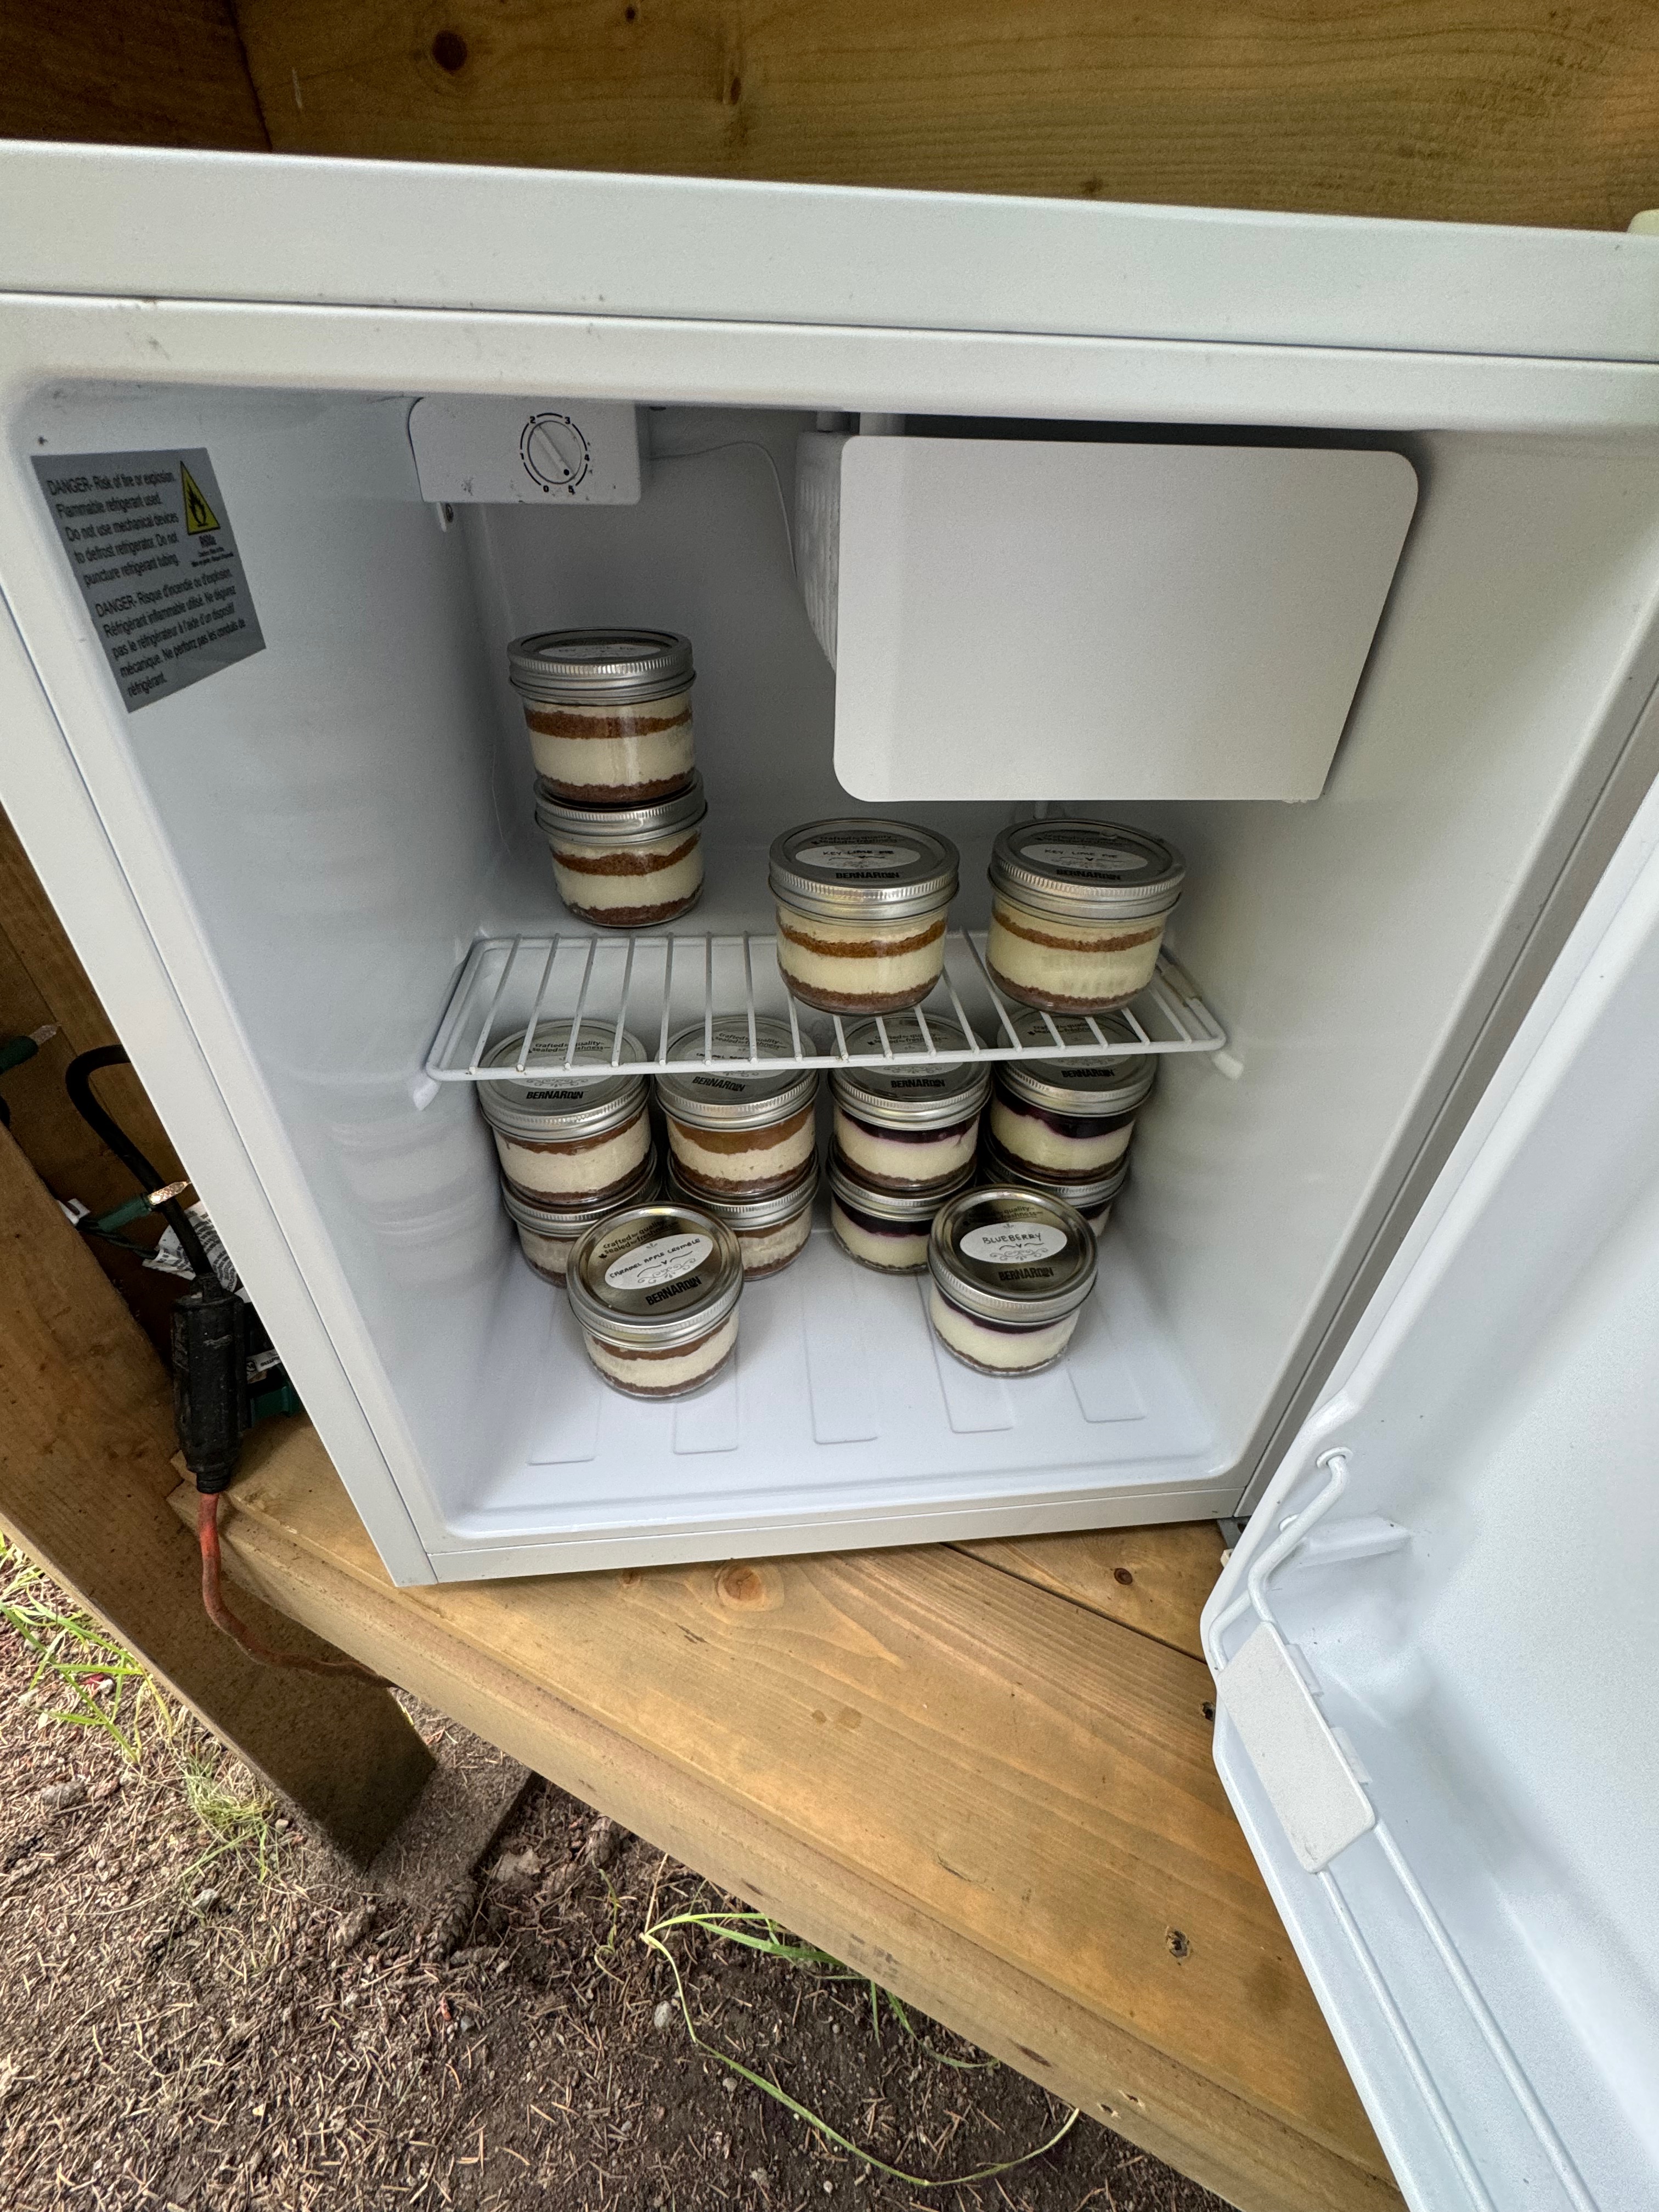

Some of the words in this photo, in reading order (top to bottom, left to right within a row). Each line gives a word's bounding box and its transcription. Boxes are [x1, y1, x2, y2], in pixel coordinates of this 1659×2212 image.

[93, 475, 114, 489] Risk
[66, 527, 81, 541] Do
[81, 524, 97, 538] not
[96, 524, 113, 537] use
[74, 549, 86, 564] to
[155, 533, 167, 546] Do
[83, 568, 121, 589] puncture
[137, 589, 163, 605] Risque
[112, 645, 129, 661] pas
[692, 1076, 746, 1092] BERNARDIN
[890, 1079, 945, 1088] BERNARDIN
[526, 1090, 584, 1099] BERNARDIN
[603, 1234, 632, 1249] crafted
[982, 1232, 1041, 1245] BLUEBERRY
[604, 1242, 630, 1254] sealed
[609, 1262, 642, 1278] CARAMEL
[644, 1252, 665, 1263] APPLE
[667, 1238, 701, 1254] CRUMBLE
[998, 1267, 1054, 1281] BERNARDIN
[645, 1276, 702, 1306] BERNARDIN
